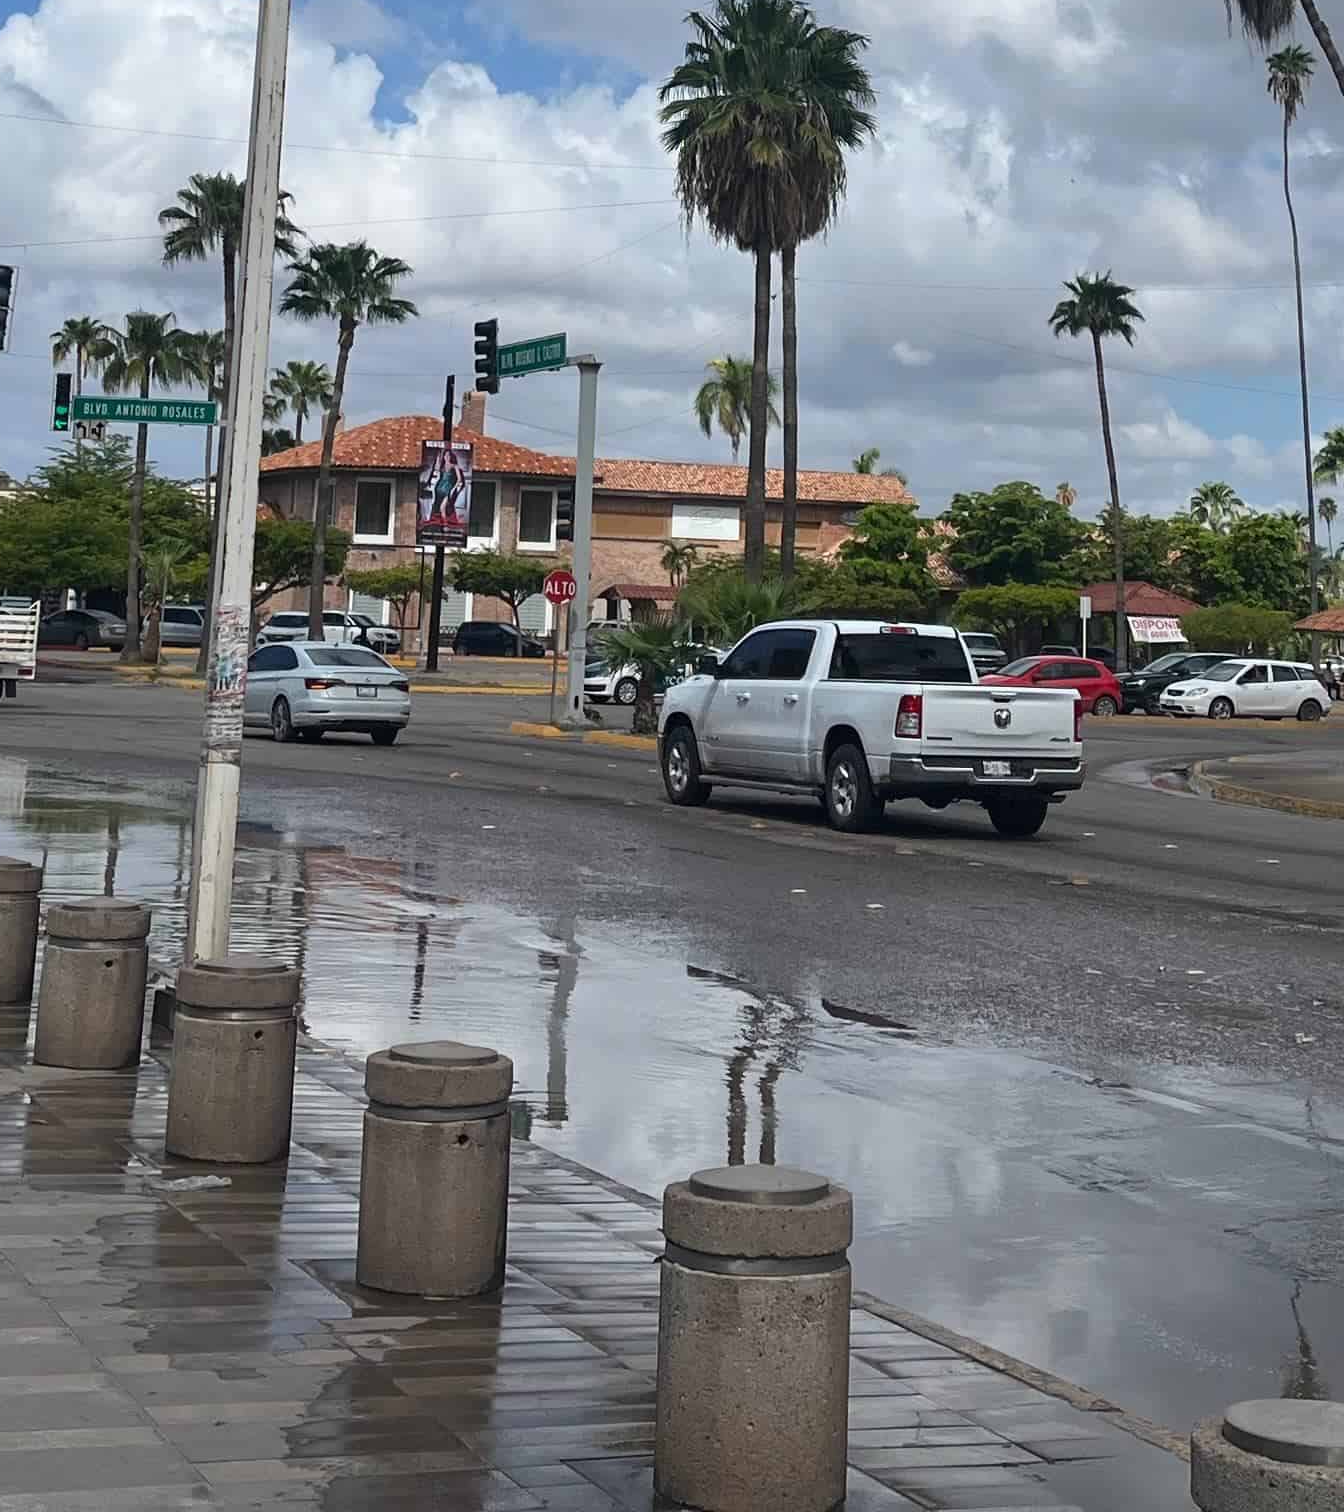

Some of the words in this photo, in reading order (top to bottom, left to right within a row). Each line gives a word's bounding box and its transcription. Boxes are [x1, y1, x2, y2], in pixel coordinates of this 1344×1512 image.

[83, 402, 111, 416] BLVD.
[115, 403, 157, 418] ANTONIO
[161, 405, 206, 420] ROSALES
[546, 580, 576, 596] ALTO
